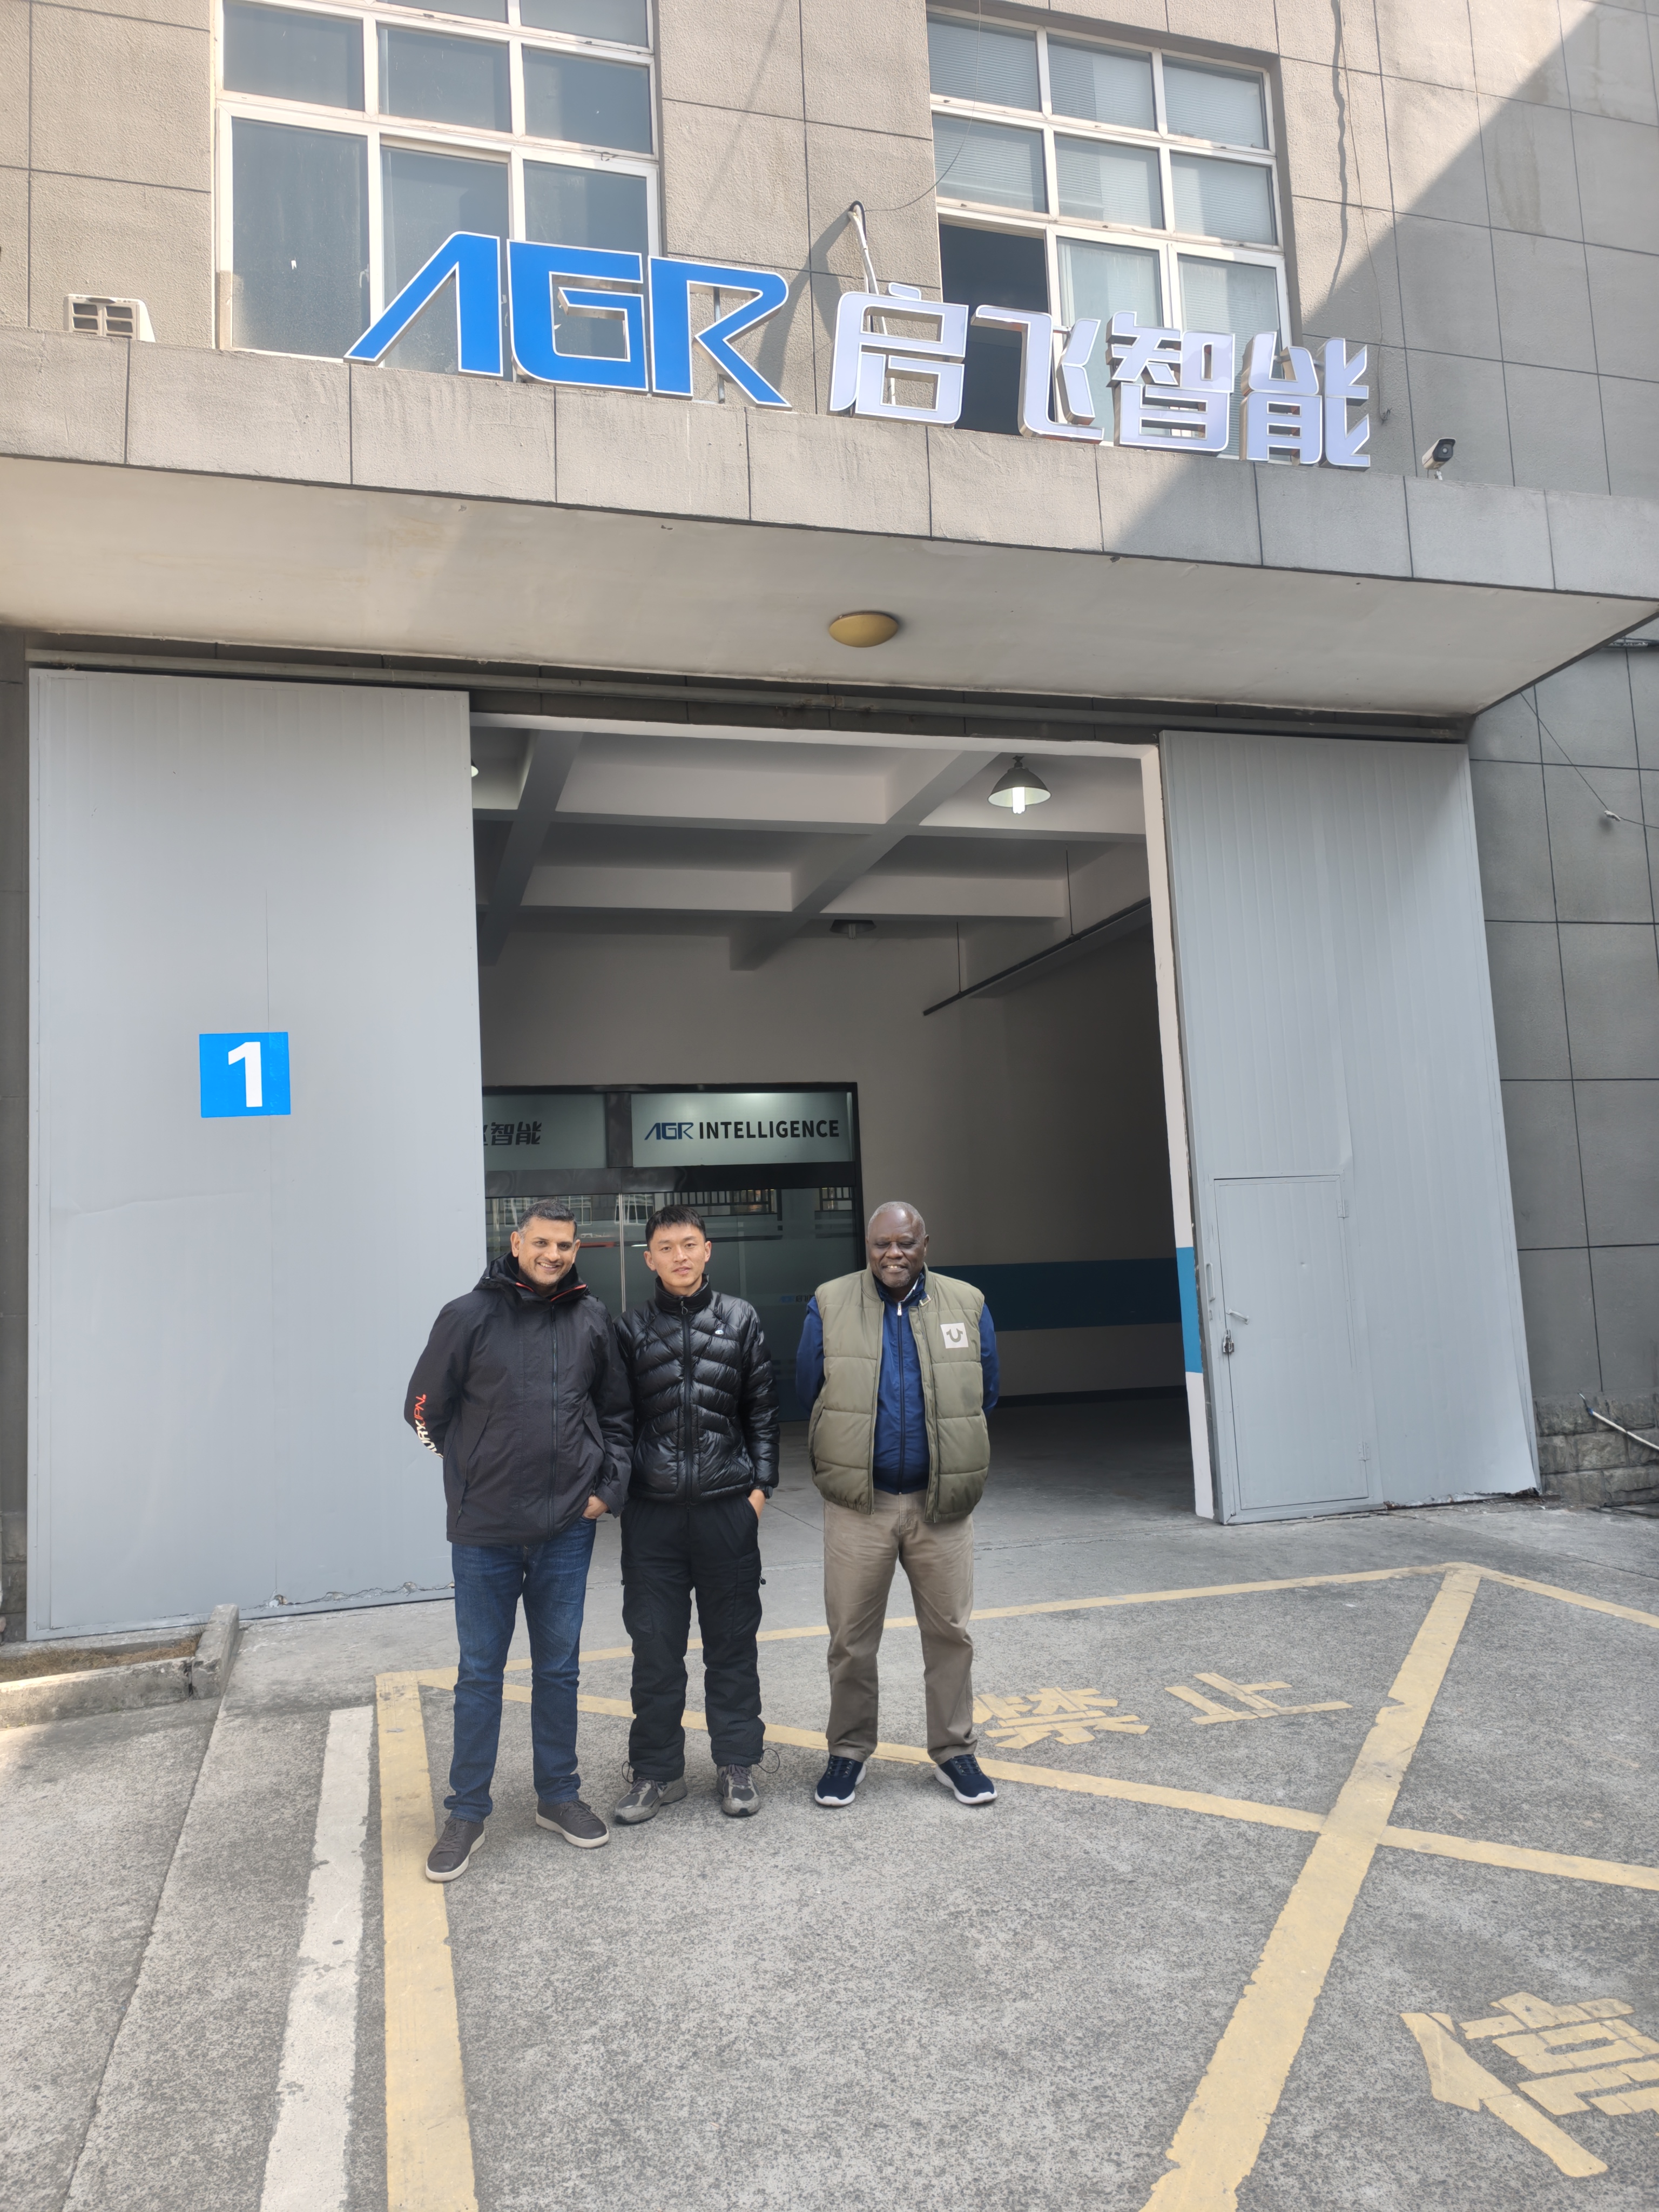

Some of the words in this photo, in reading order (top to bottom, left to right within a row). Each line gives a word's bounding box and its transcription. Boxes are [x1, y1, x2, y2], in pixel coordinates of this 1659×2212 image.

[831, 282, 1372, 470] 启飞智能
[228, 1041, 263, 1108] 1
[699, 1120, 839, 1139] INTELLIGENCE
[972, 1673, 1353, 1749] 禁止
